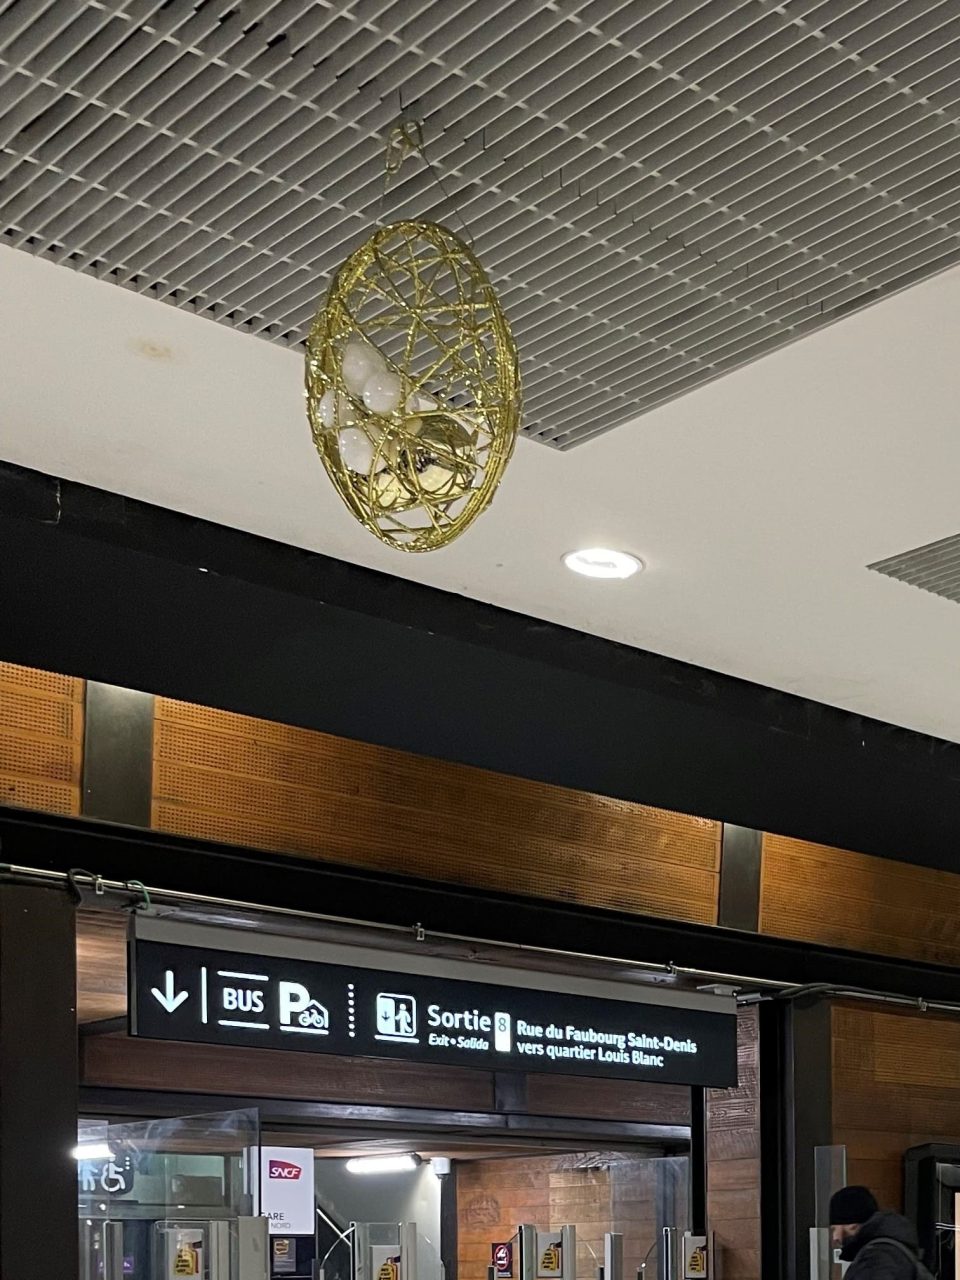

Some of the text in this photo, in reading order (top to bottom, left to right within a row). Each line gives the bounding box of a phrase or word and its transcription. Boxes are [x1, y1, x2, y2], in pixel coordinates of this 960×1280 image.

[222, 987, 265, 1013] BUS
[427, 1004, 492, 1032] Sortie
[498, 1017, 507, 1033] 8
[516, 1019, 698, 1054] Rue du Faubourg Saint-Denis
[516, 1041, 665, 1067] vers quartier Louis Blanc
[270, 1167, 300, 1178] SNCF
[261, 1212, 285, 1221] ARE
